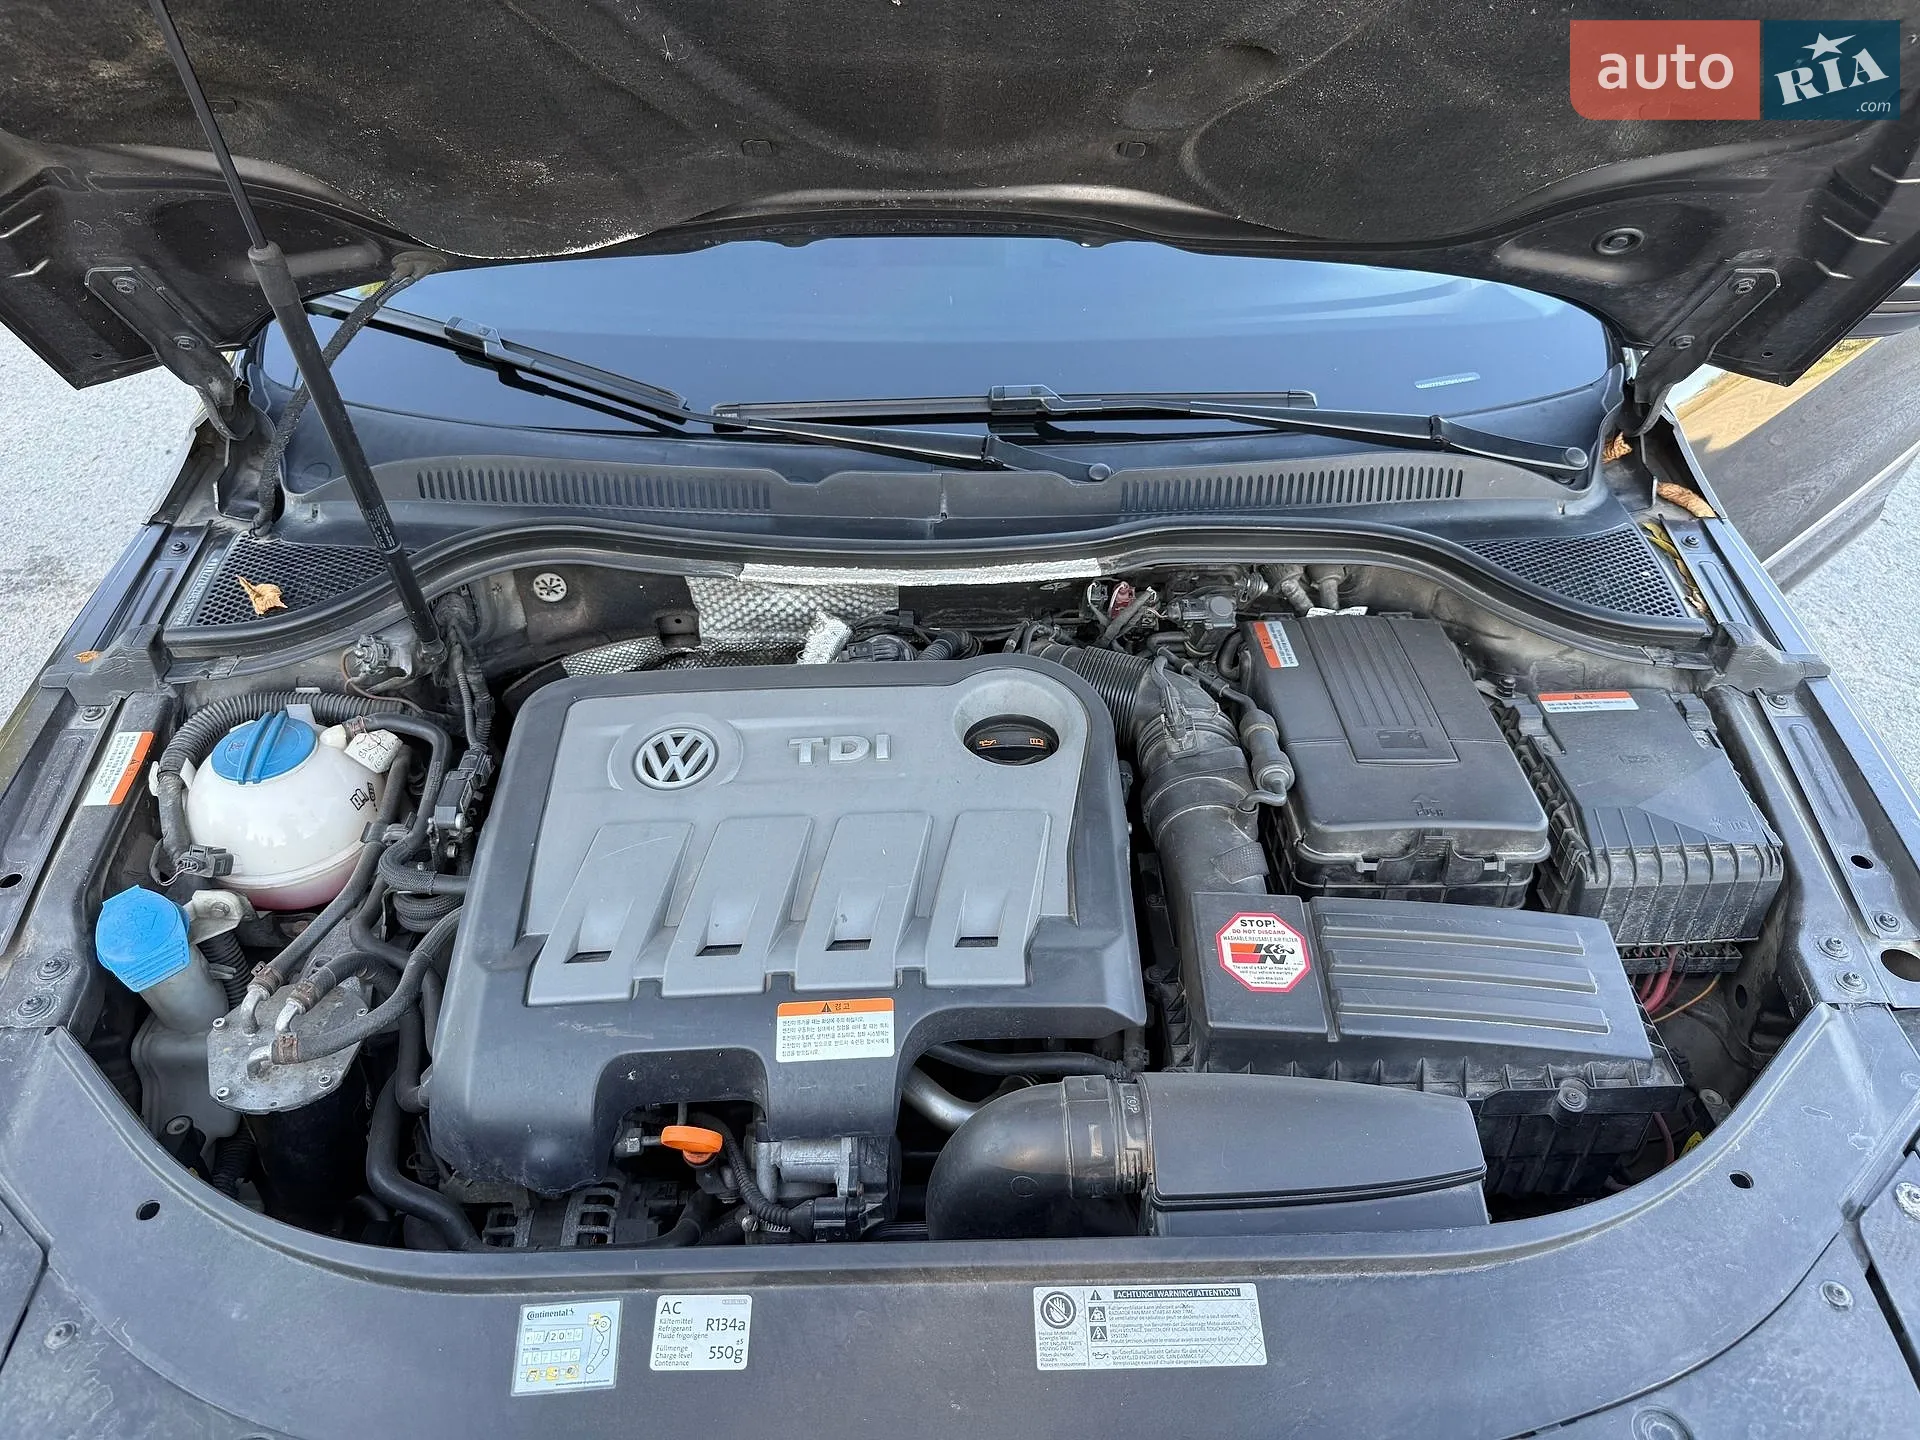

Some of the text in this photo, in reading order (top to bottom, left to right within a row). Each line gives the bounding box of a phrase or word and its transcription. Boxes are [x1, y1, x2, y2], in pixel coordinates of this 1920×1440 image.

[789, 734, 891, 764] TDI
[1116, 1288, 1239, 1298] ACHTUNG! WARNING! ATTENTION!
[527, 1308, 569, 1320] Continental
[660, 1302, 682, 1314] AC
[706, 1318, 746, 1331] R134a
[656, 1345, 688, 1353] Füllmenge
[709, 1345, 743, 1363] 550g
[655, 1352, 676, 1360] Charge
